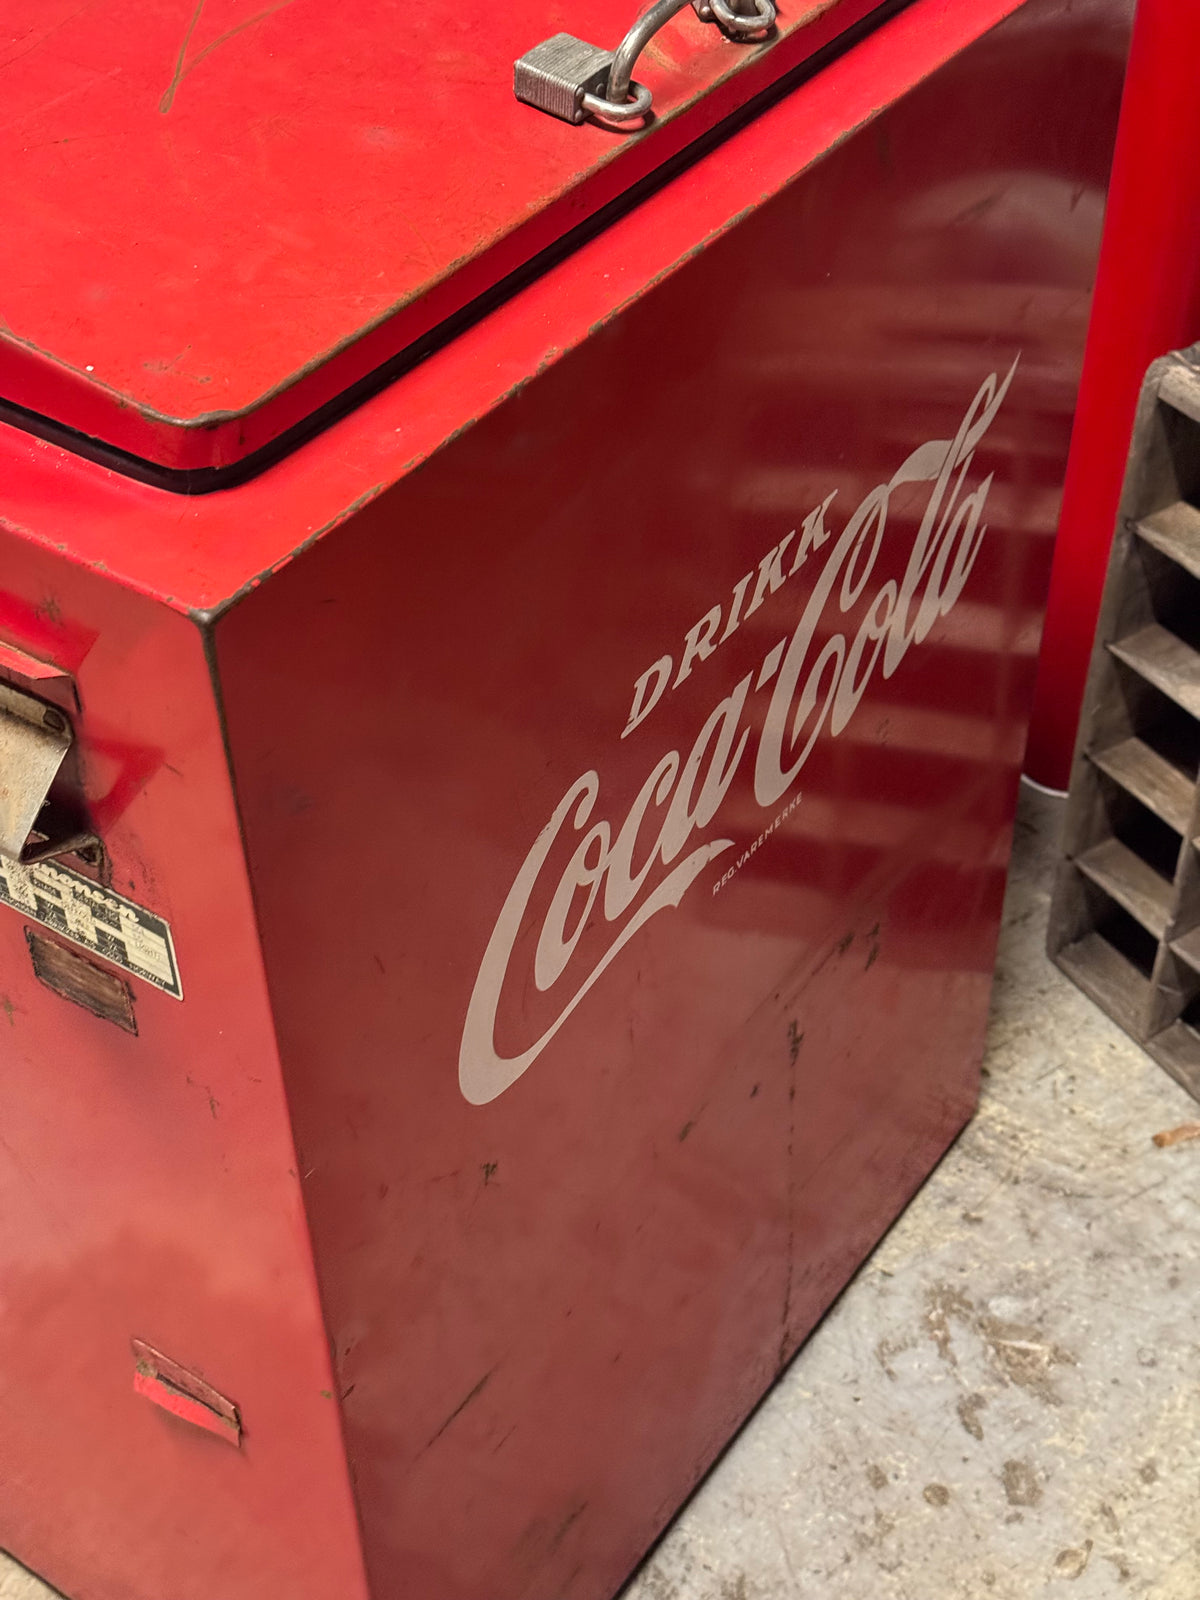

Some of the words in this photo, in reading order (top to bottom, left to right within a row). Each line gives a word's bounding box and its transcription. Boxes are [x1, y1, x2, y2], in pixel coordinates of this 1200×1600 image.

[458, 350, 1022, 1106] Coca-Cola
[620, 489, 838, 740] DRIKK
[712, 865, 738, 896] REG.
[736, 791, 803, 869] VAREMERKE
